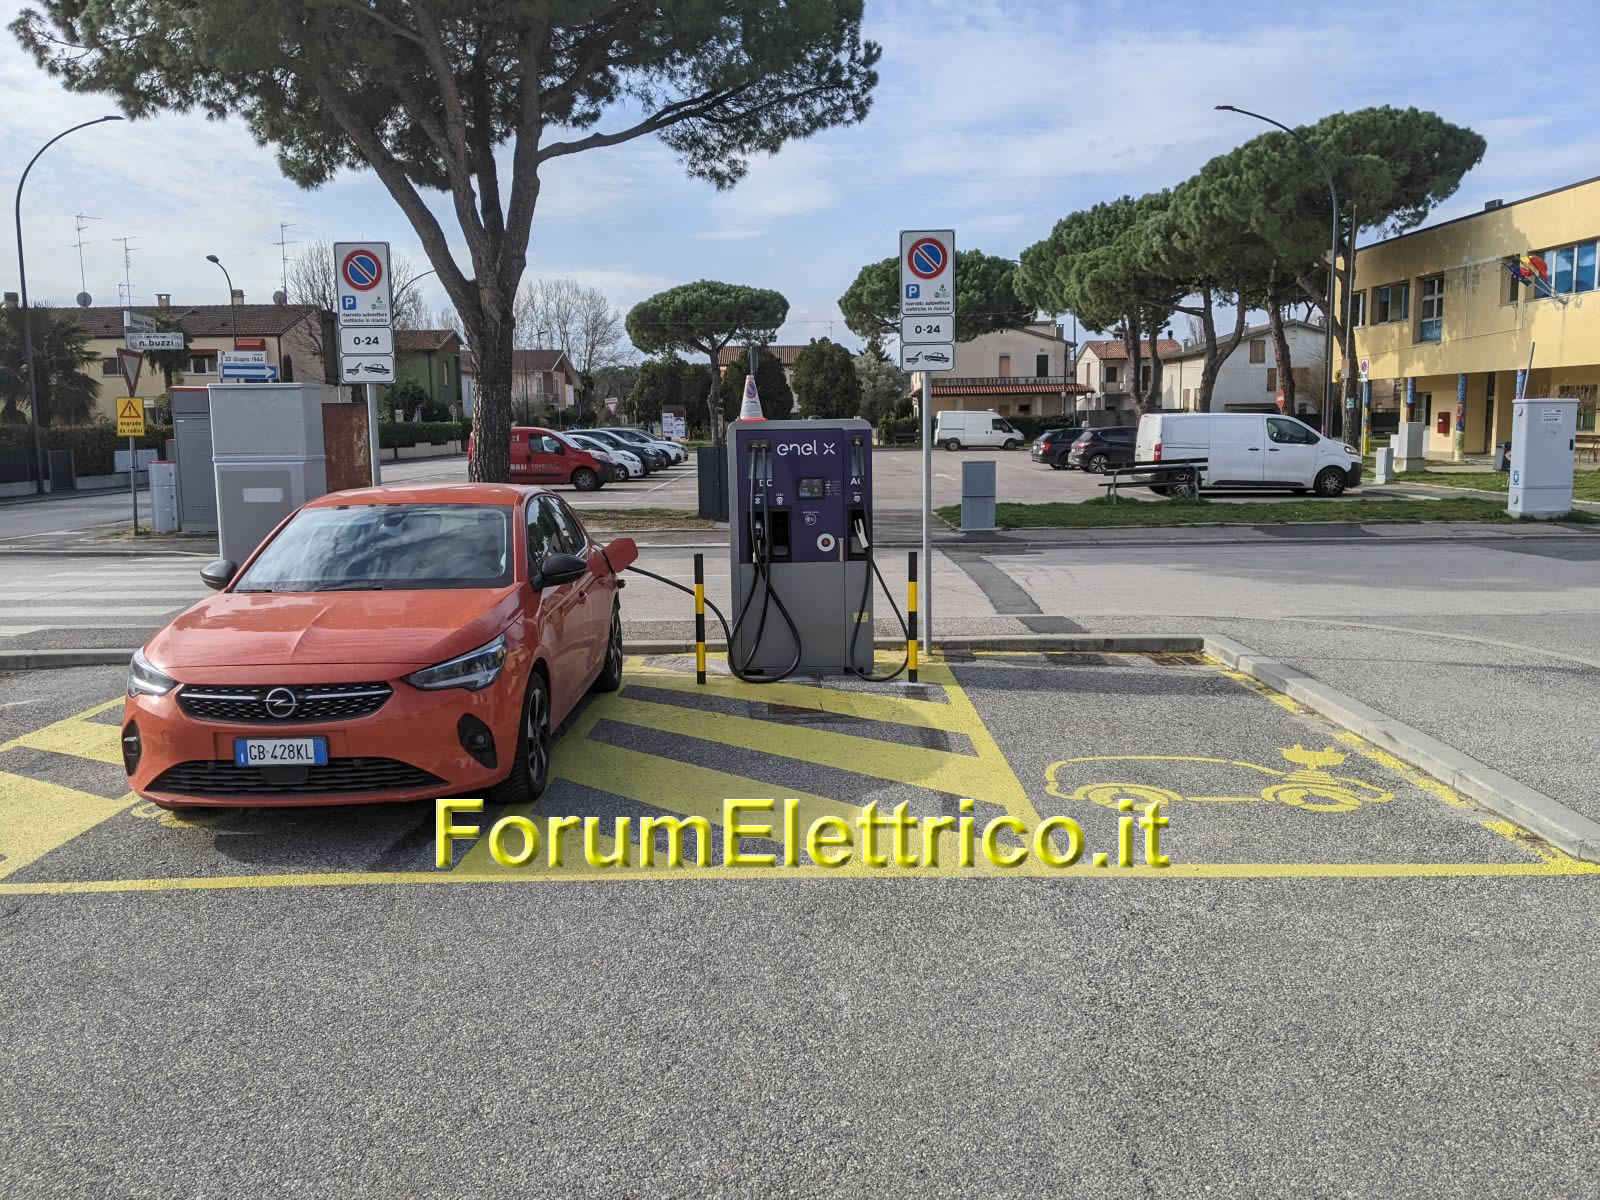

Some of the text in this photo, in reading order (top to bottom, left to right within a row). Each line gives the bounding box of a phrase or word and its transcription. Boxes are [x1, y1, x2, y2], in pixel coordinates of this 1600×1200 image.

[915, 325, 940, 334] 0-24
[149, 339, 174, 347] buzzi
[353, 336, 379, 345] 0-24
[776, 440, 818, 456] enel
[249, 743, 314, 761] GB 428KL
